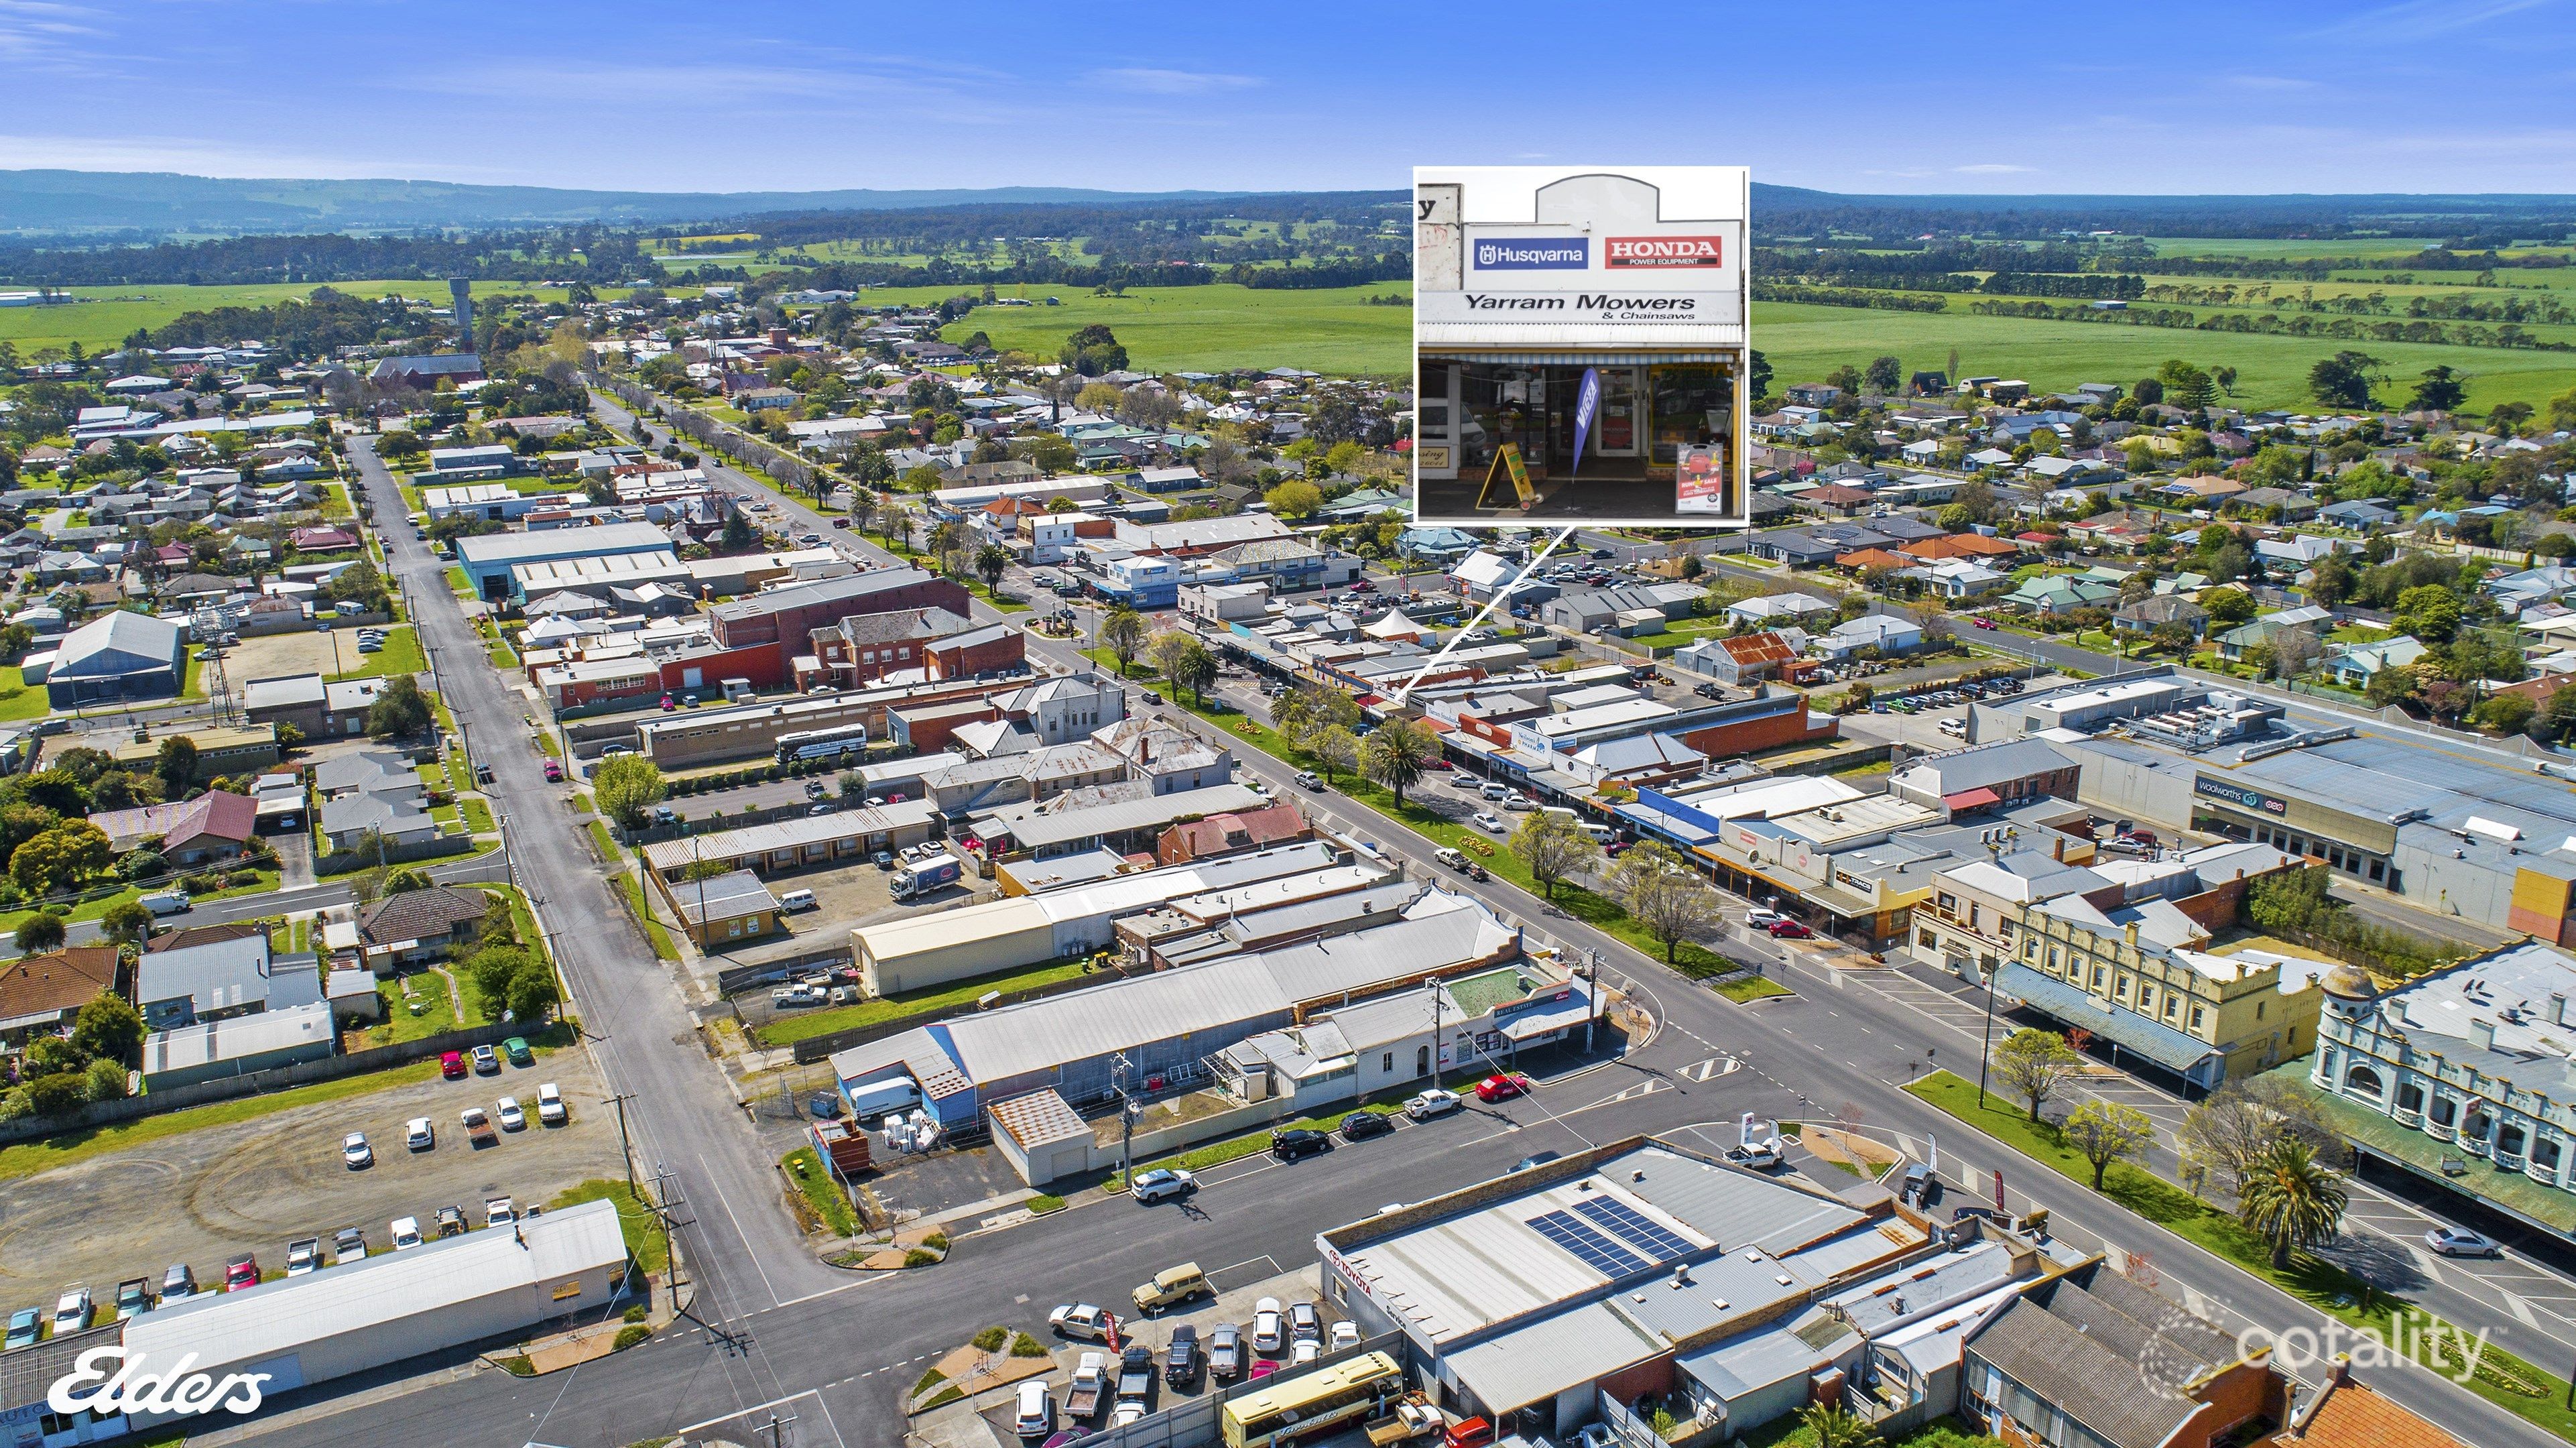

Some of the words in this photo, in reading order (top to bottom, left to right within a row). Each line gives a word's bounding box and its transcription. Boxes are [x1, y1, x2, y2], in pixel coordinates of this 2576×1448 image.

[1497, 247, 1583, 263] Husqvarna
[1611, 241, 1717, 257] HONDA
[1465, 294, 1565, 310] Yarram
[1577, 294, 1696, 310] Mowers
[1621, 312, 1695, 320] Chainsaws
[1522, 741, 1545, 754] PHARMACY
[2199, 781, 2242, 800] Woolworths
[1497, 1008, 1512, 1016] REAL
[1513, 1002, 1533, 1012] ESTATE
[1341, 1261, 1372, 1297] TOYOTA
[1386, 1305, 1406, 1330] Service
